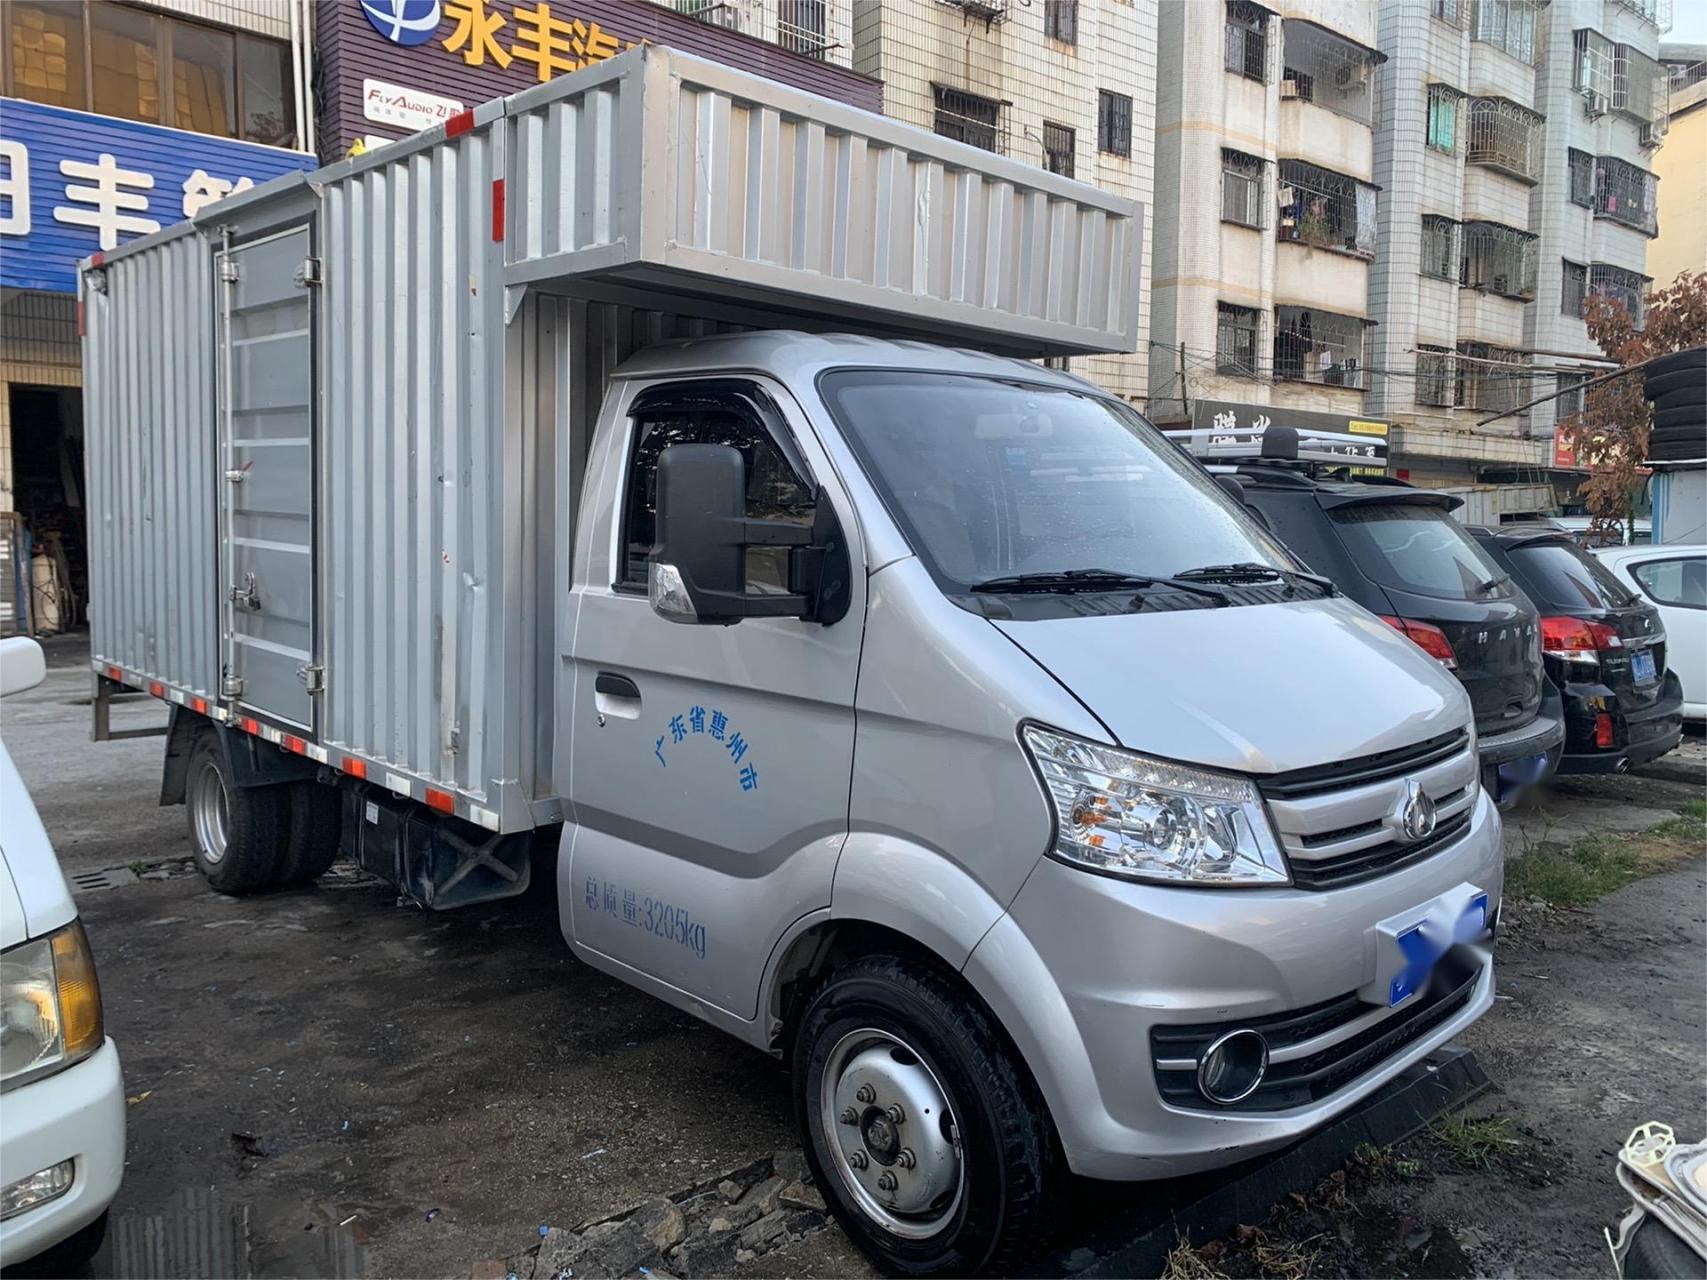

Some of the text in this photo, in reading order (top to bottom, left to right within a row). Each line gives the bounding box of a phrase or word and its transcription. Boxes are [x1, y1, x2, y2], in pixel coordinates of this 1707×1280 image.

[442, 0, 652, 82] 永丰汽
[655, 705, 758, 792] 广东省惠州市
